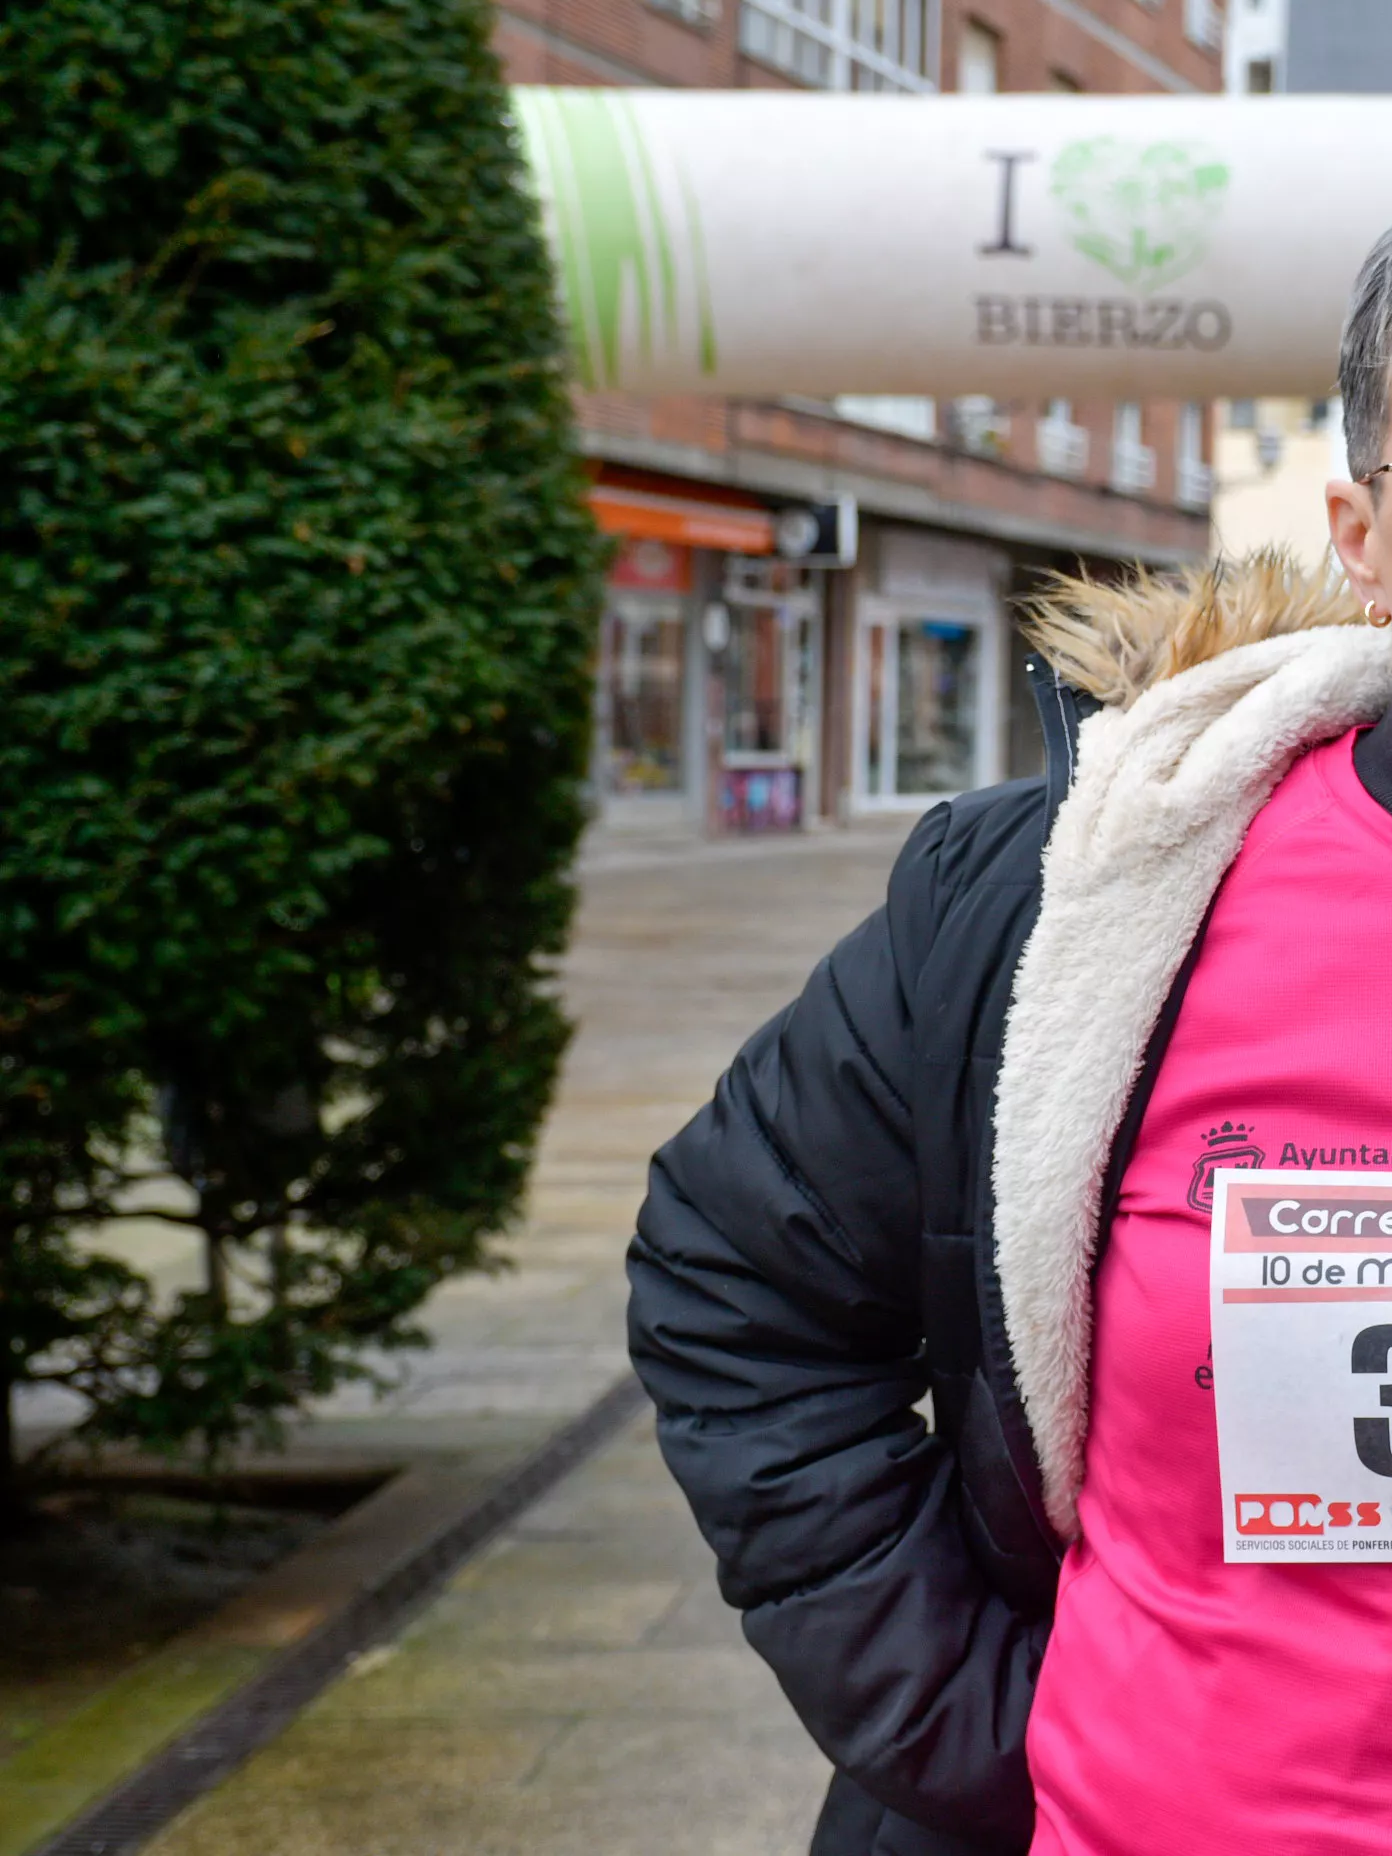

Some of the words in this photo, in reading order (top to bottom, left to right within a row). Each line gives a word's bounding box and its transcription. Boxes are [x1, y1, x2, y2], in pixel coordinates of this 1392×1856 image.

[979, 148, 1036, 257] I
[974, 296, 1232, 350] BIERZO
[1262, 1255, 1292, 1286] 10
[1301, 1259, 1346, 1285] de
[1235, 1540, 1286, 1551] SERVICIOS
[1287, 1540, 1335, 1551] SOCIALES
[1336, 1540, 1350, 1551] DE
